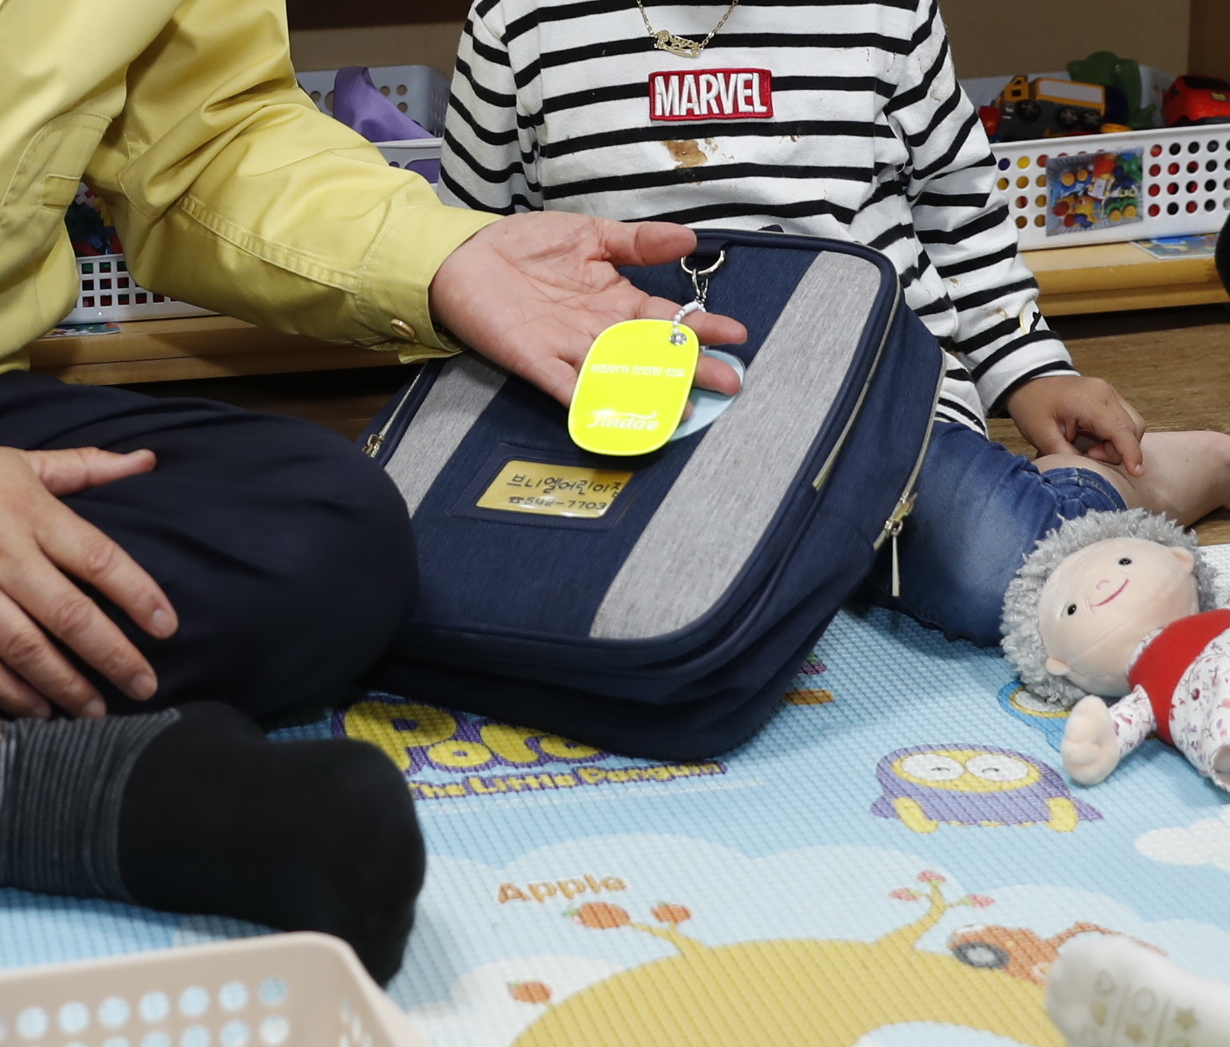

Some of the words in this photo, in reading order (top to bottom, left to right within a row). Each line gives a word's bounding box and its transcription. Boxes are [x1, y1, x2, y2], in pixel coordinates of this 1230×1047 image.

[654, 73, 768, 116] MARVEL
[468, 774, 577, 793] Little
[577, 761, 722, 786] Penguin
[497, 873, 626, 904] Apple
